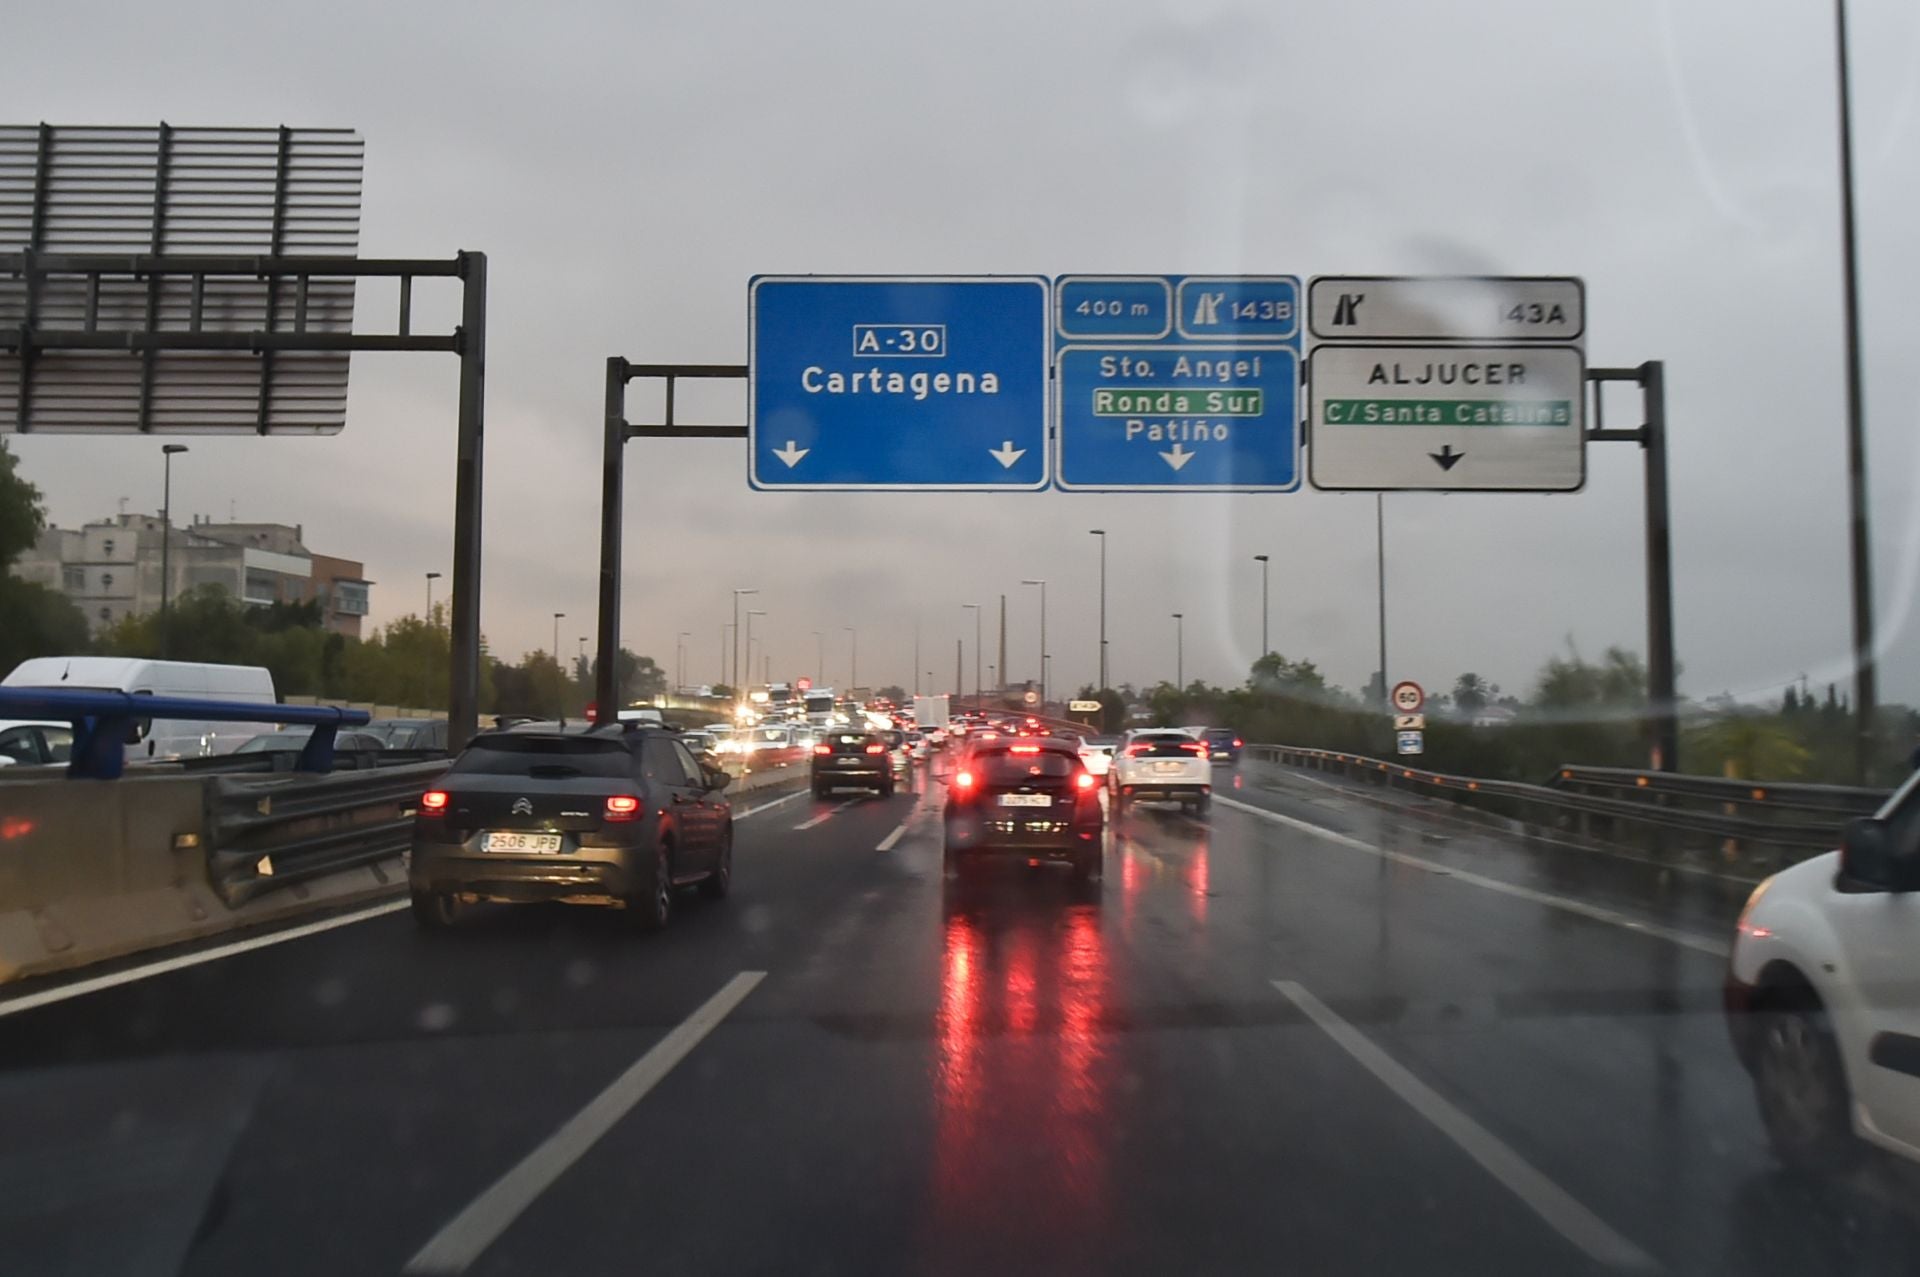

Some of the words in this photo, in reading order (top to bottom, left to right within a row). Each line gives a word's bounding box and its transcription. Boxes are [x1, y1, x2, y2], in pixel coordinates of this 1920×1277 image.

[1076, 301, 1123, 316] 400
[1131, 303, 1149, 316] m
[1231, 302, 1292, 320] 143B
[859, 330, 939, 351] A-30
[1100, 356, 1155, 378] Sto.
[1172, 356, 1261, 382] Angel
[1368, 363, 1526, 385] ALJUCER
[802, 366, 999, 400] Cartagena
[1097, 391, 1190, 412] Ronda
[1206, 391, 1260, 412] Sur
[1327, 403, 1442, 422] C/Santa
[1456, 403, 1569, 422] Catalina
[1126, 420, 1229, 440] Patiño
[490, 835, 526, 848] 2506
